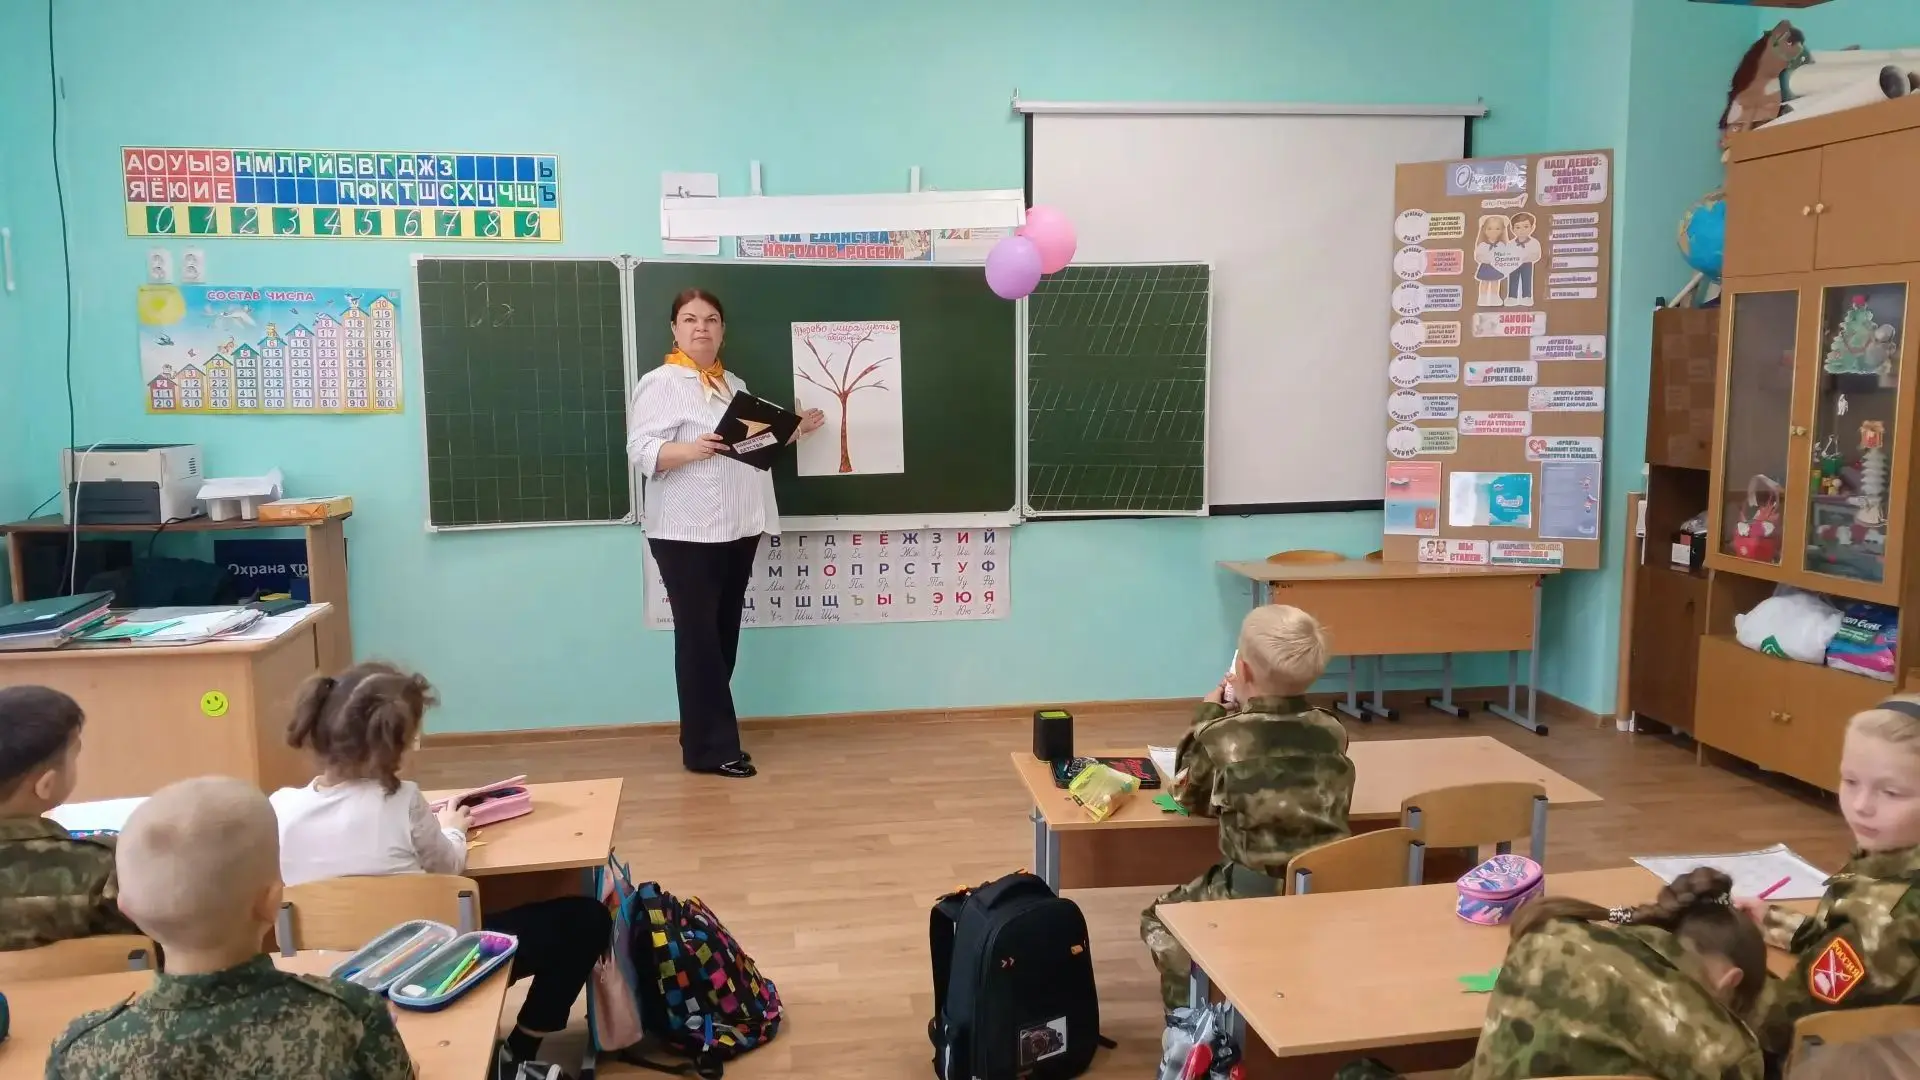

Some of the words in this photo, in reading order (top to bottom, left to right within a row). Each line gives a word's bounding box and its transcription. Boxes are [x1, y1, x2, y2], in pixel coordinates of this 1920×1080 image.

[1544, 159, 1566, 169] НАШ
[1568, 157, 1602, 168] ДЕВИЗ:
[156, 206, 174, 233] 0
[205, 207, 216, 233] 1
[240, 207, 258, 234] 2
[282, 208, 299, 235] 3
[324, 210, 341, 235] 4
[359, 209, 380, 235] 5
[404, 209, 420, 236] 6
[443, 210, 460, 236] 7
[484, 210, 500, 237] 8
[523, 211, 540, 237] 9
[763, 243, 838, 259] НАРОДОВ
[846, 245, 905, 259] РОССИИ
[207, 291, 261, 300] СОСТАВ
[265, 292, 314, 301] ЧИСЛА
[1499, 314, 1535, 323] ЗАКОНЫ
[1504, 326, 1532, 334] ОРЛЯТ
[1482, 375, 1508, 383] ДЕРЖАТ
[770, 535, 781, 547] В
[799, 535, 807, 546] Г
[824, 535, 836, 546] Д
[852, 534, 861, 545] Е
[880, 531, 889, 545] Ё
[902, 533, 918, 544] Ж
[932, 533, 941, 544] З
[958, 532, 968, 543] И
[984, 528, 994, 543] Й
[228, 563, 286, 578] Охрана
[769, 566, 782, 577] М
[798, 565, 809, 576] Н
[823, 564, 836, 576] О
[852, 564, 863, 575] П
[880, 564, 889, 575] Р
[905, 563, 915, 574] С
[931, 563, 941, 573] Т
[958, 562, 968, 573] У
[982, 560, 995, 572] Ф
[771, 597, 781, 607] Ч
[796, 596, 811, 607] Ш
[822, 595, 839, 608] Щ
[878, 594, 891, 605] Ы
[933, 592, 943, 603] Э
[955, 591, 972, 603] Ю
[984, 591, 994, 602] Я
[1832, 940, 1860, 978] РОССИЯ
